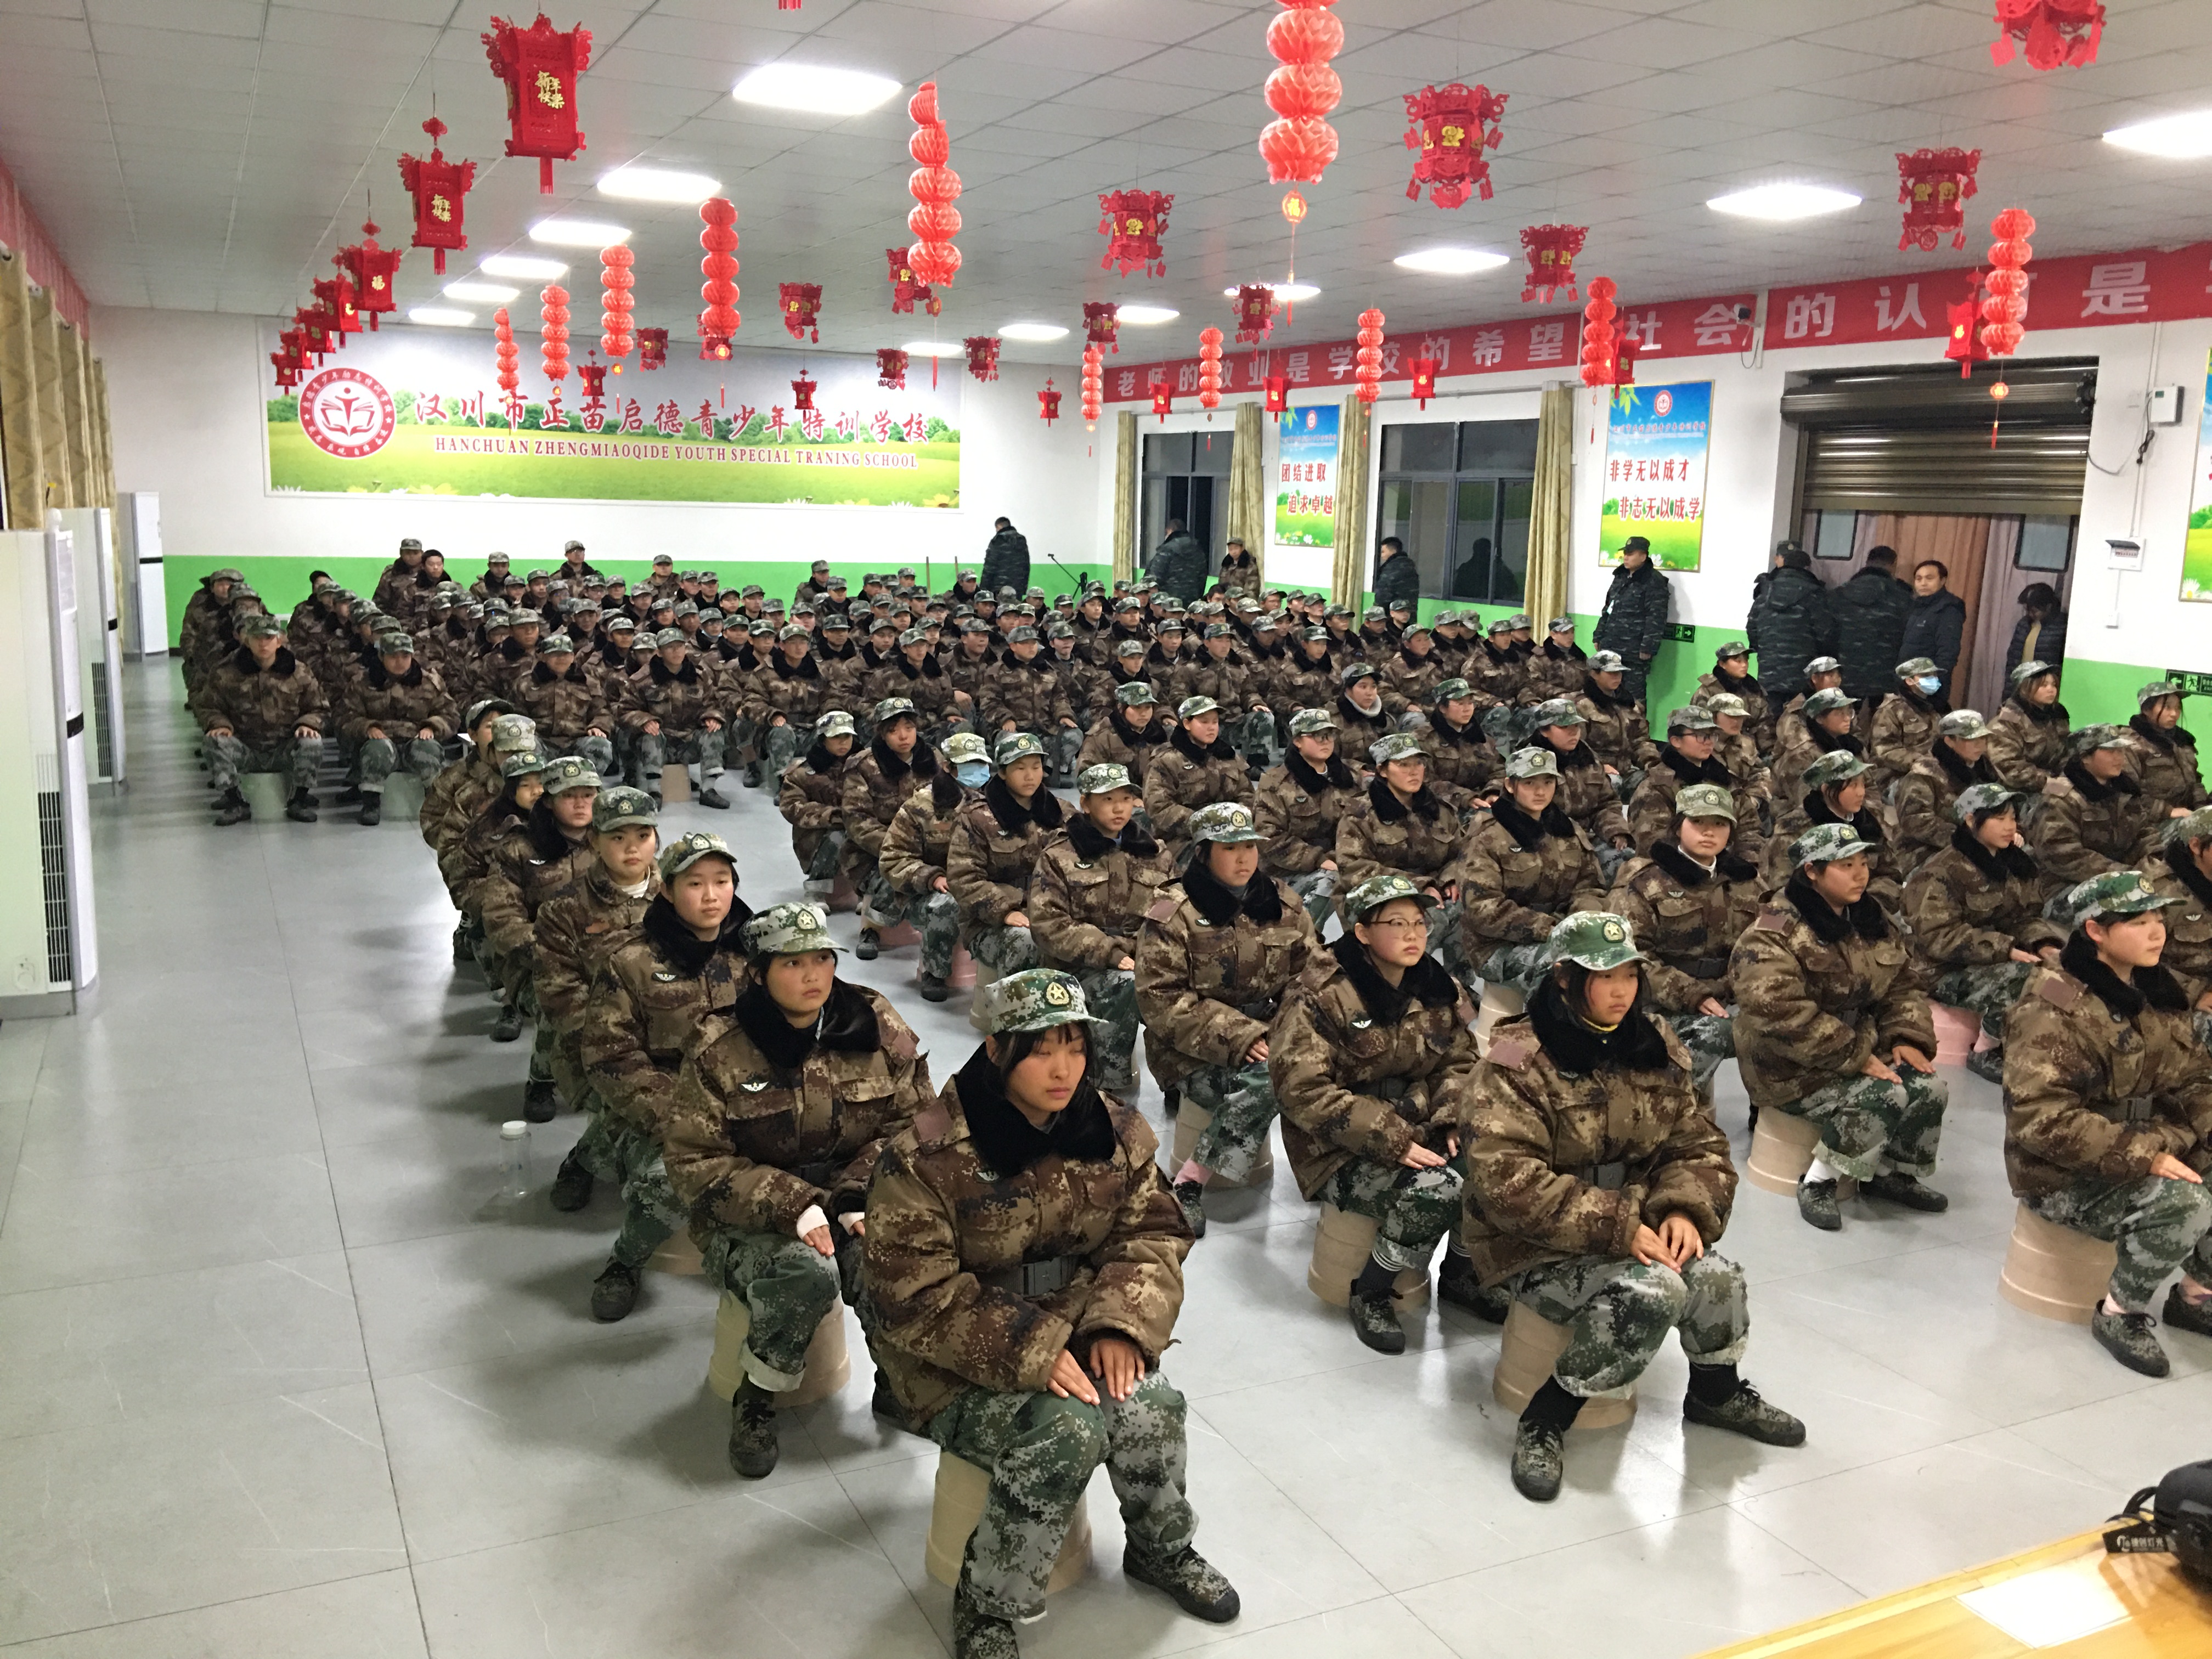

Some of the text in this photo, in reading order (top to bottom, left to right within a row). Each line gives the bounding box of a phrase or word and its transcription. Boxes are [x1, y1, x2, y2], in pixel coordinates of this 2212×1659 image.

[417, 390, 927, 442] 汉川市正苗启德青少年特训学校
[436, 438, 917, 467] HANCHUAN ZHENGMIAOQIDE YOUTH SPECIAL TRANING SCHOOL
[1282, 463, 1326, 482] 团结进取
[1610, 459, 1689, 482] 非学无以成才
[1288, 495, 1333, 514] 追求卓越
[1620, 496, 1700, 520] 非志无以成学
